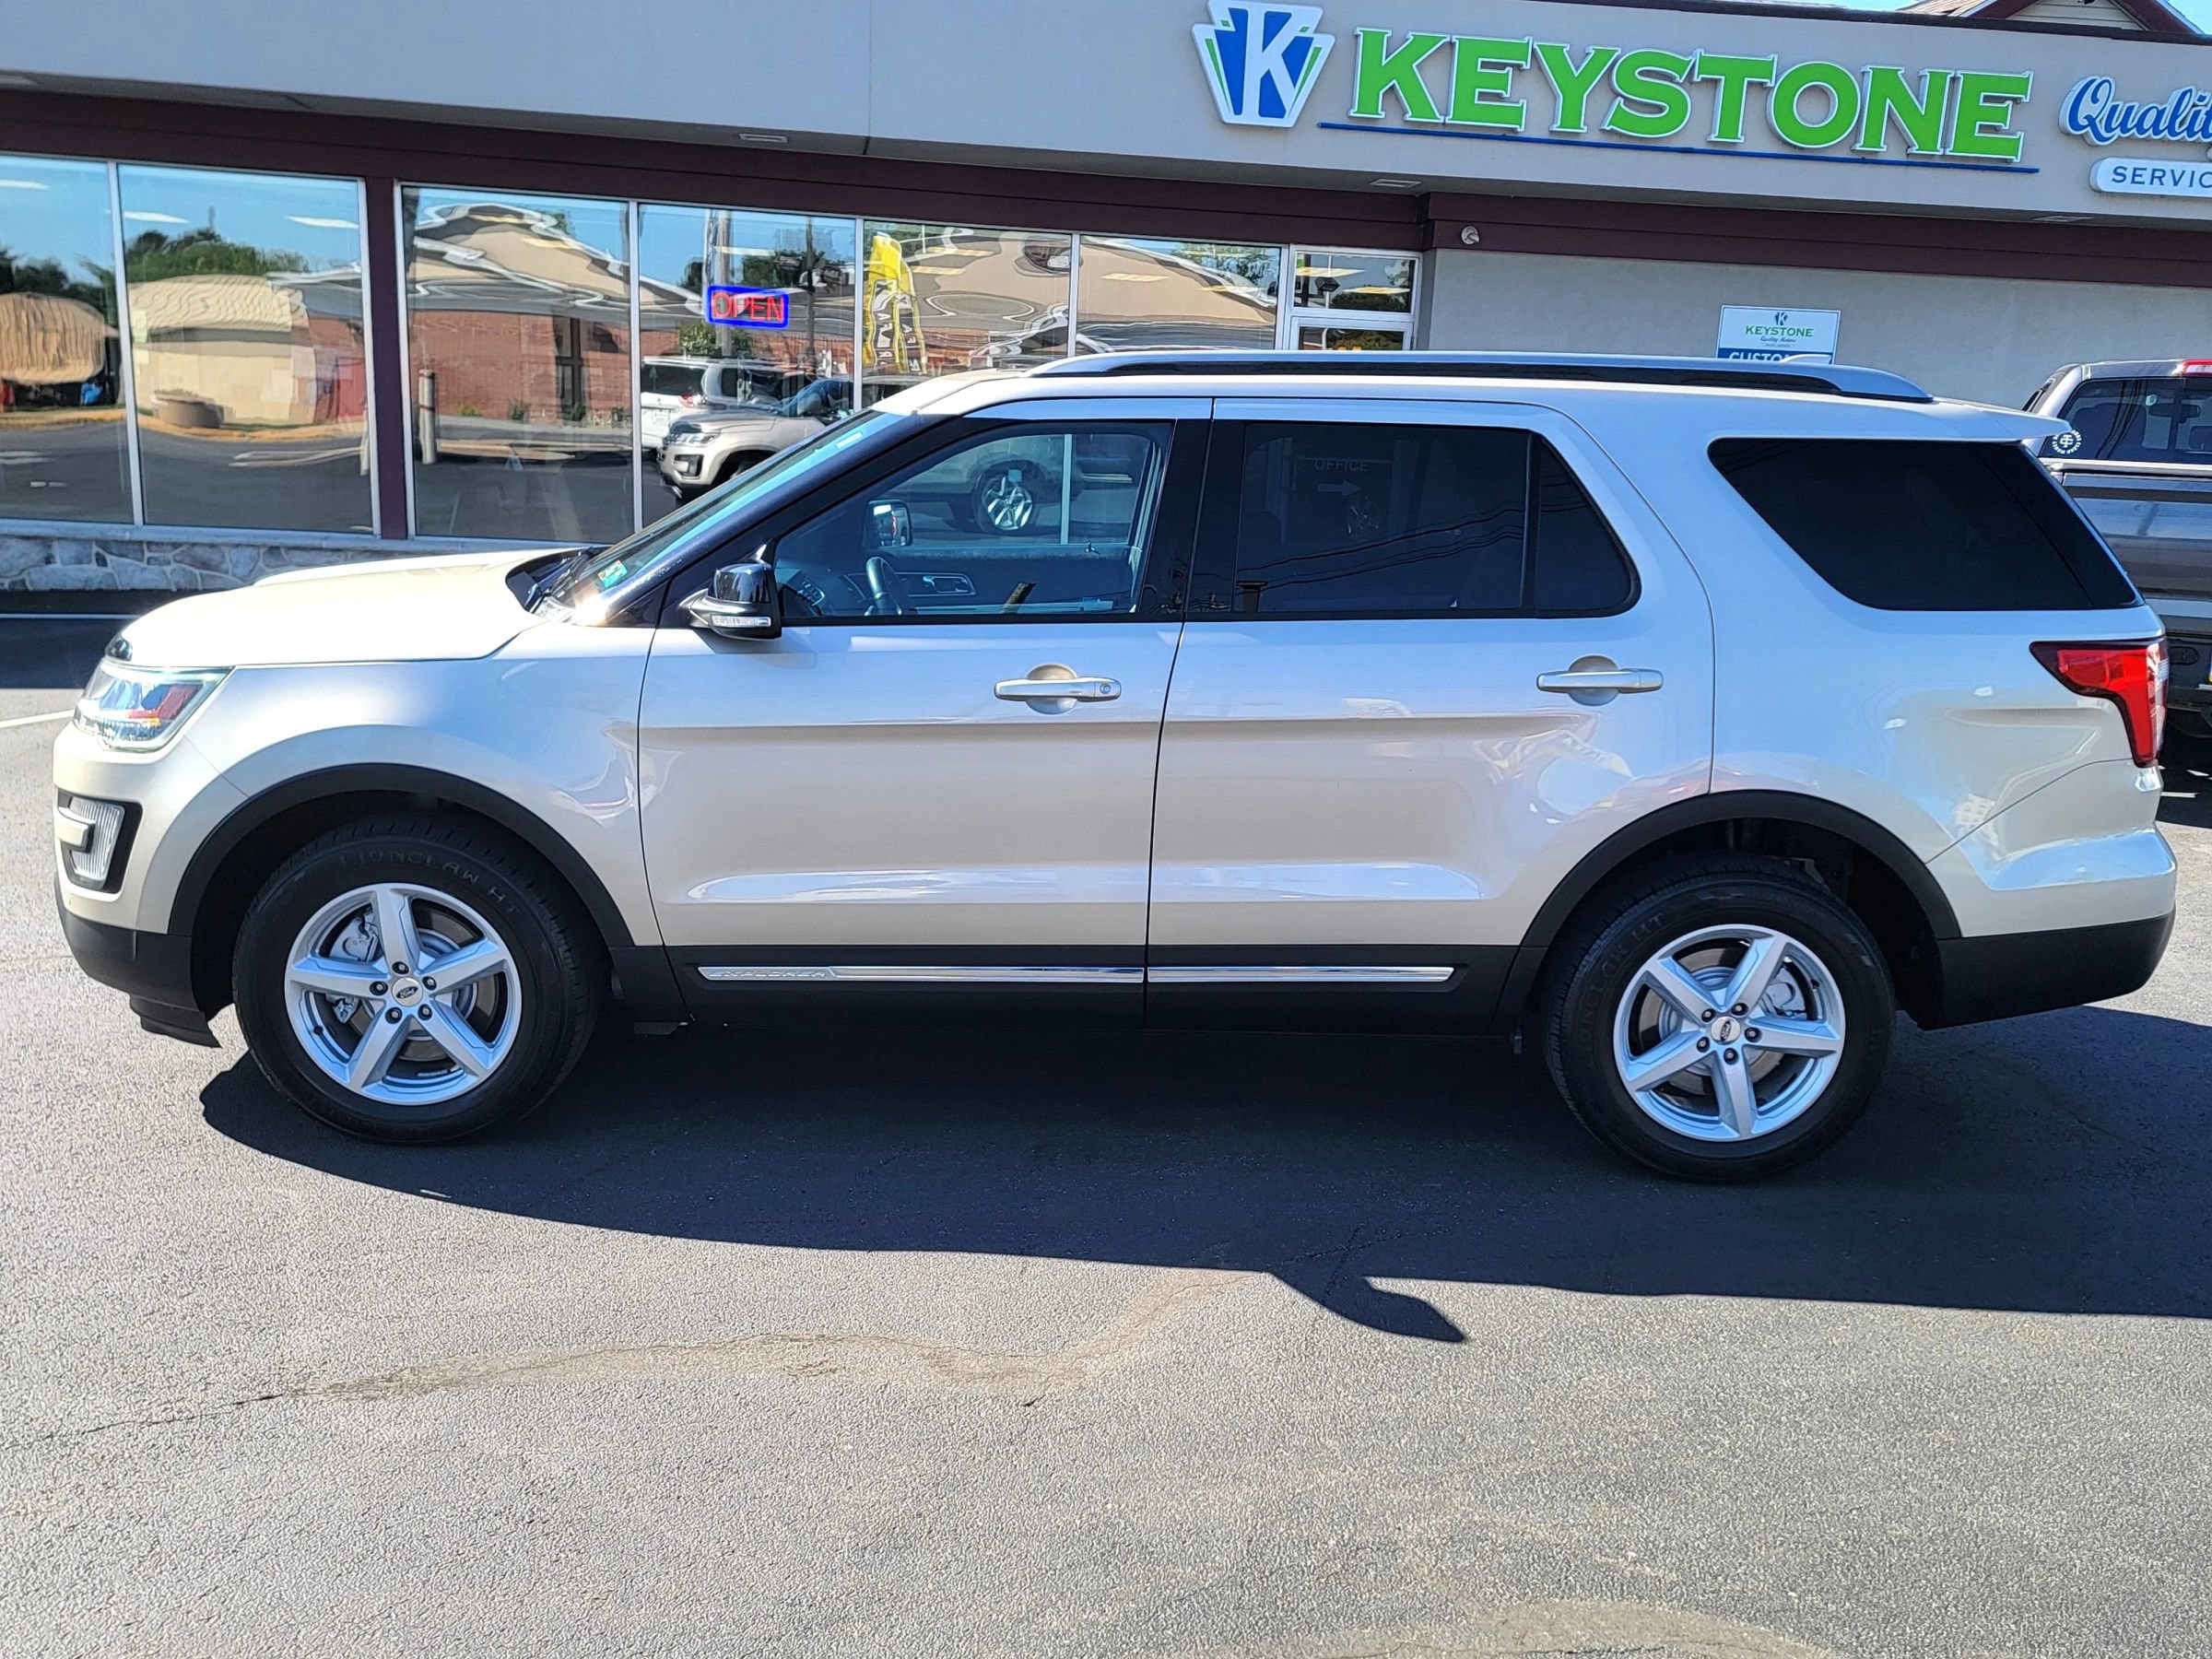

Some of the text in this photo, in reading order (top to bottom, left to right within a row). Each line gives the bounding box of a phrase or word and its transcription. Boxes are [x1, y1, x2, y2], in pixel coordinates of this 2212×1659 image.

[1348, 27, 2034, 162] KEYSTONE
[712, 291, 784, 323] OPEN
[1745, 325, 1814, 337] KEYSTONE
[1729, 352, 1790, 360] CUSTO
[1314, 459, 1369, 472] OFFICE
